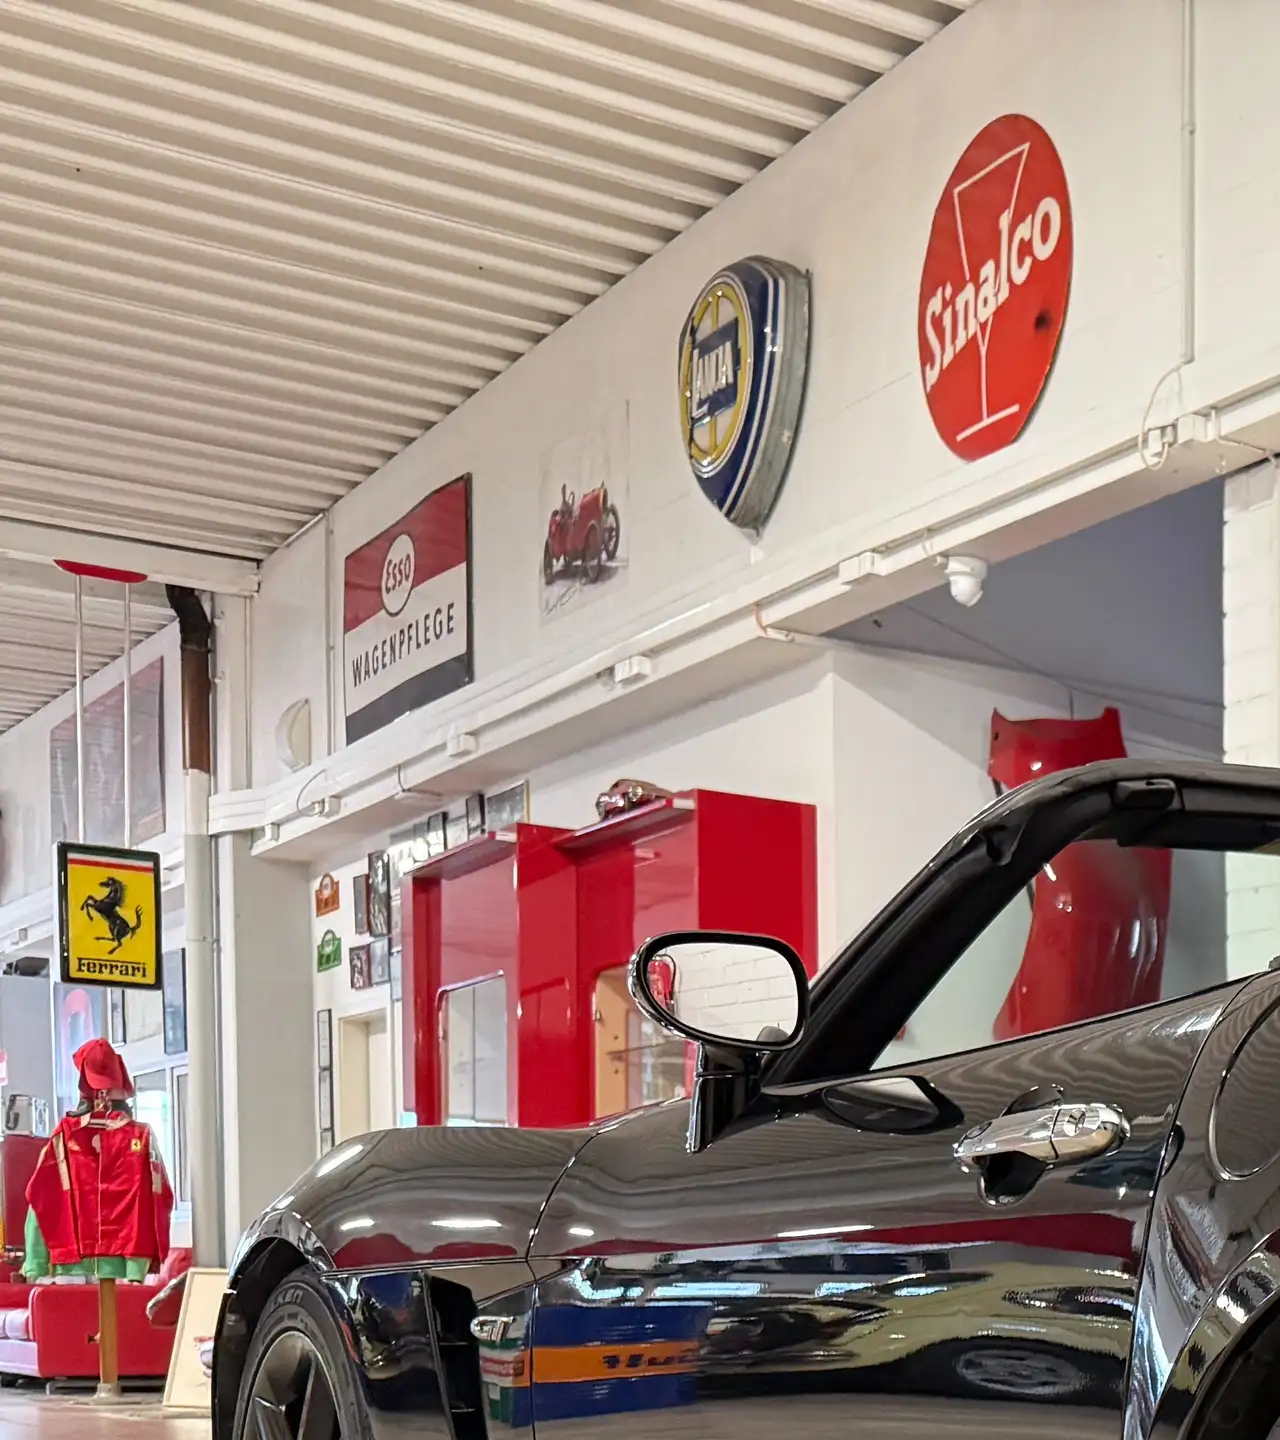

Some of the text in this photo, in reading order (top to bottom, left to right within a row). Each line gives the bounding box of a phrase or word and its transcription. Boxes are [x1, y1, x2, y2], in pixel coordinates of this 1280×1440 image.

[925, 196, 1061, 393] Sinalco
[352, 602, 455, 688] WAGENPFLEGE
[76, 957, 148, 979] Ferrari
